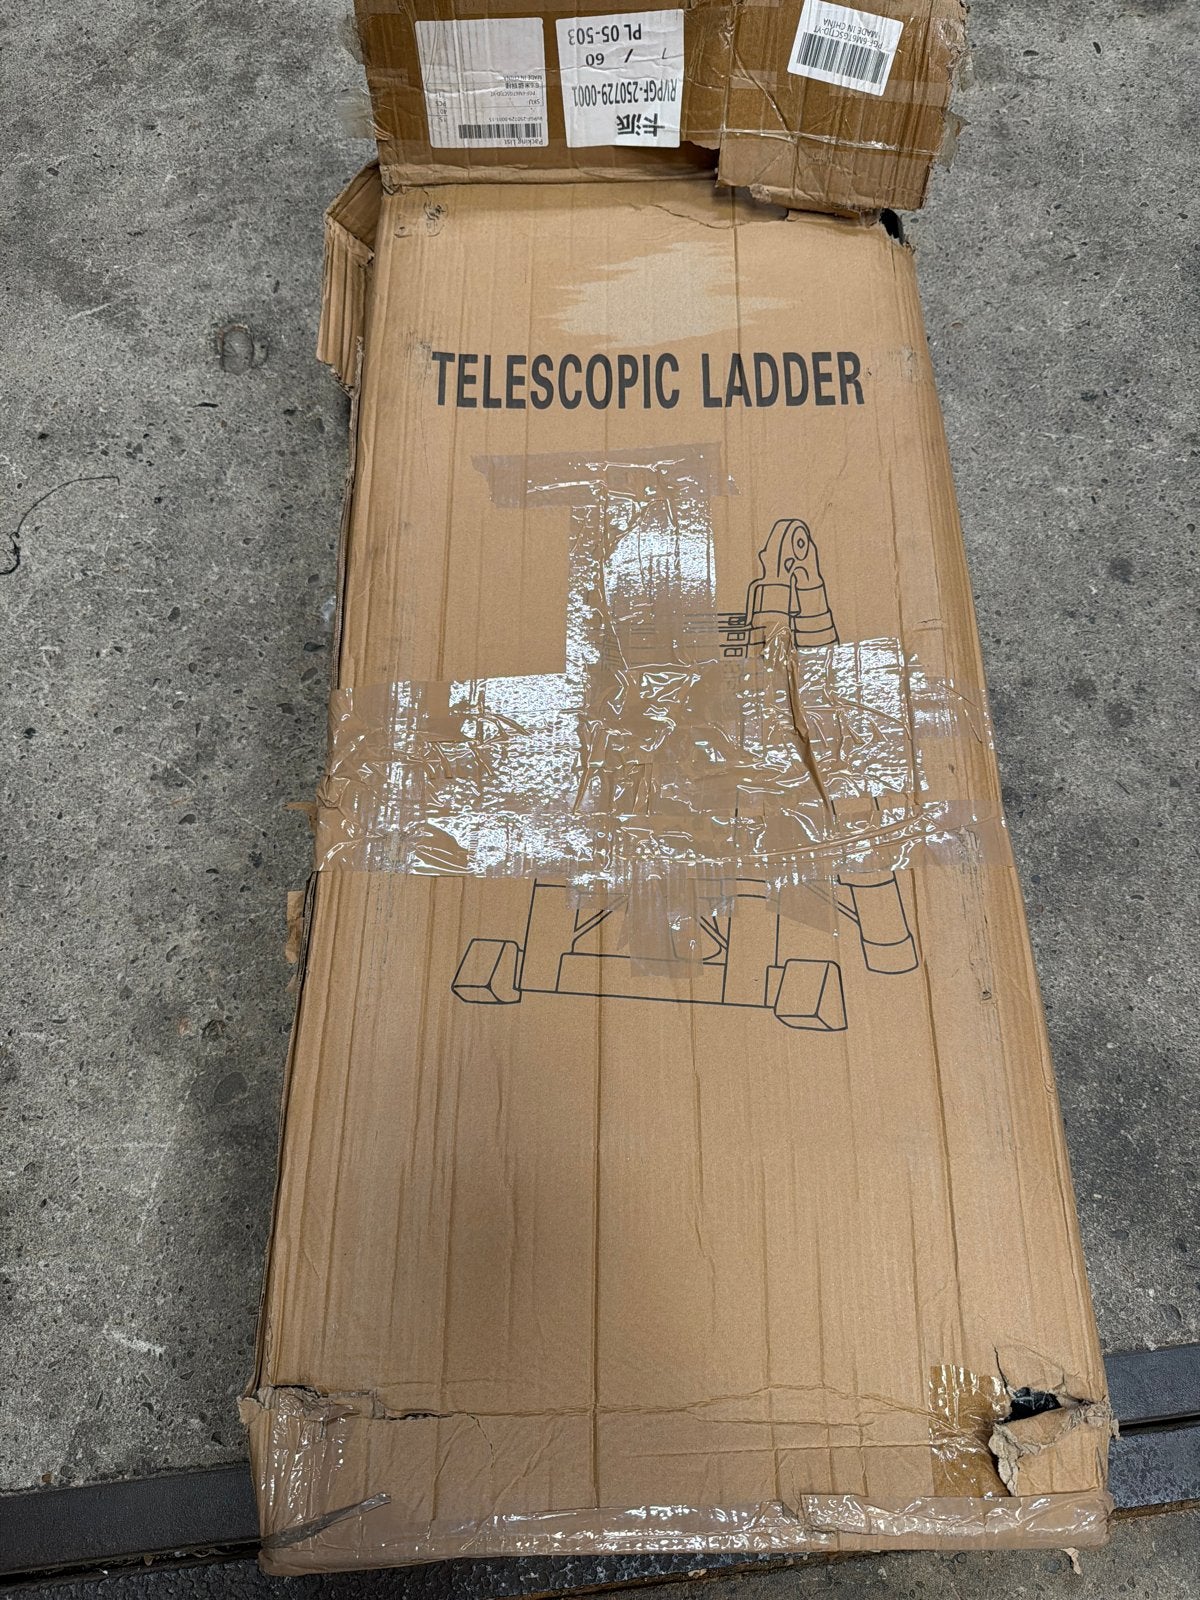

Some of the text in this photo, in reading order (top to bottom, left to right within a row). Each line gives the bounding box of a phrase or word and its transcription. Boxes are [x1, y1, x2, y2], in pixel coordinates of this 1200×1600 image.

[566, 24, 642, 46] PL 05-503
[822, 18, 878, 38] MADE IN CHINA
[584, 52, 604, 66] 60
[570, 78, 678, 106] RVPGF-250729-0001
[616, 112, 664, 136] 卡派
[518, 138, 544, 146] Packing
[432, 351, 865, 410] TELESCOPIC LADDER
